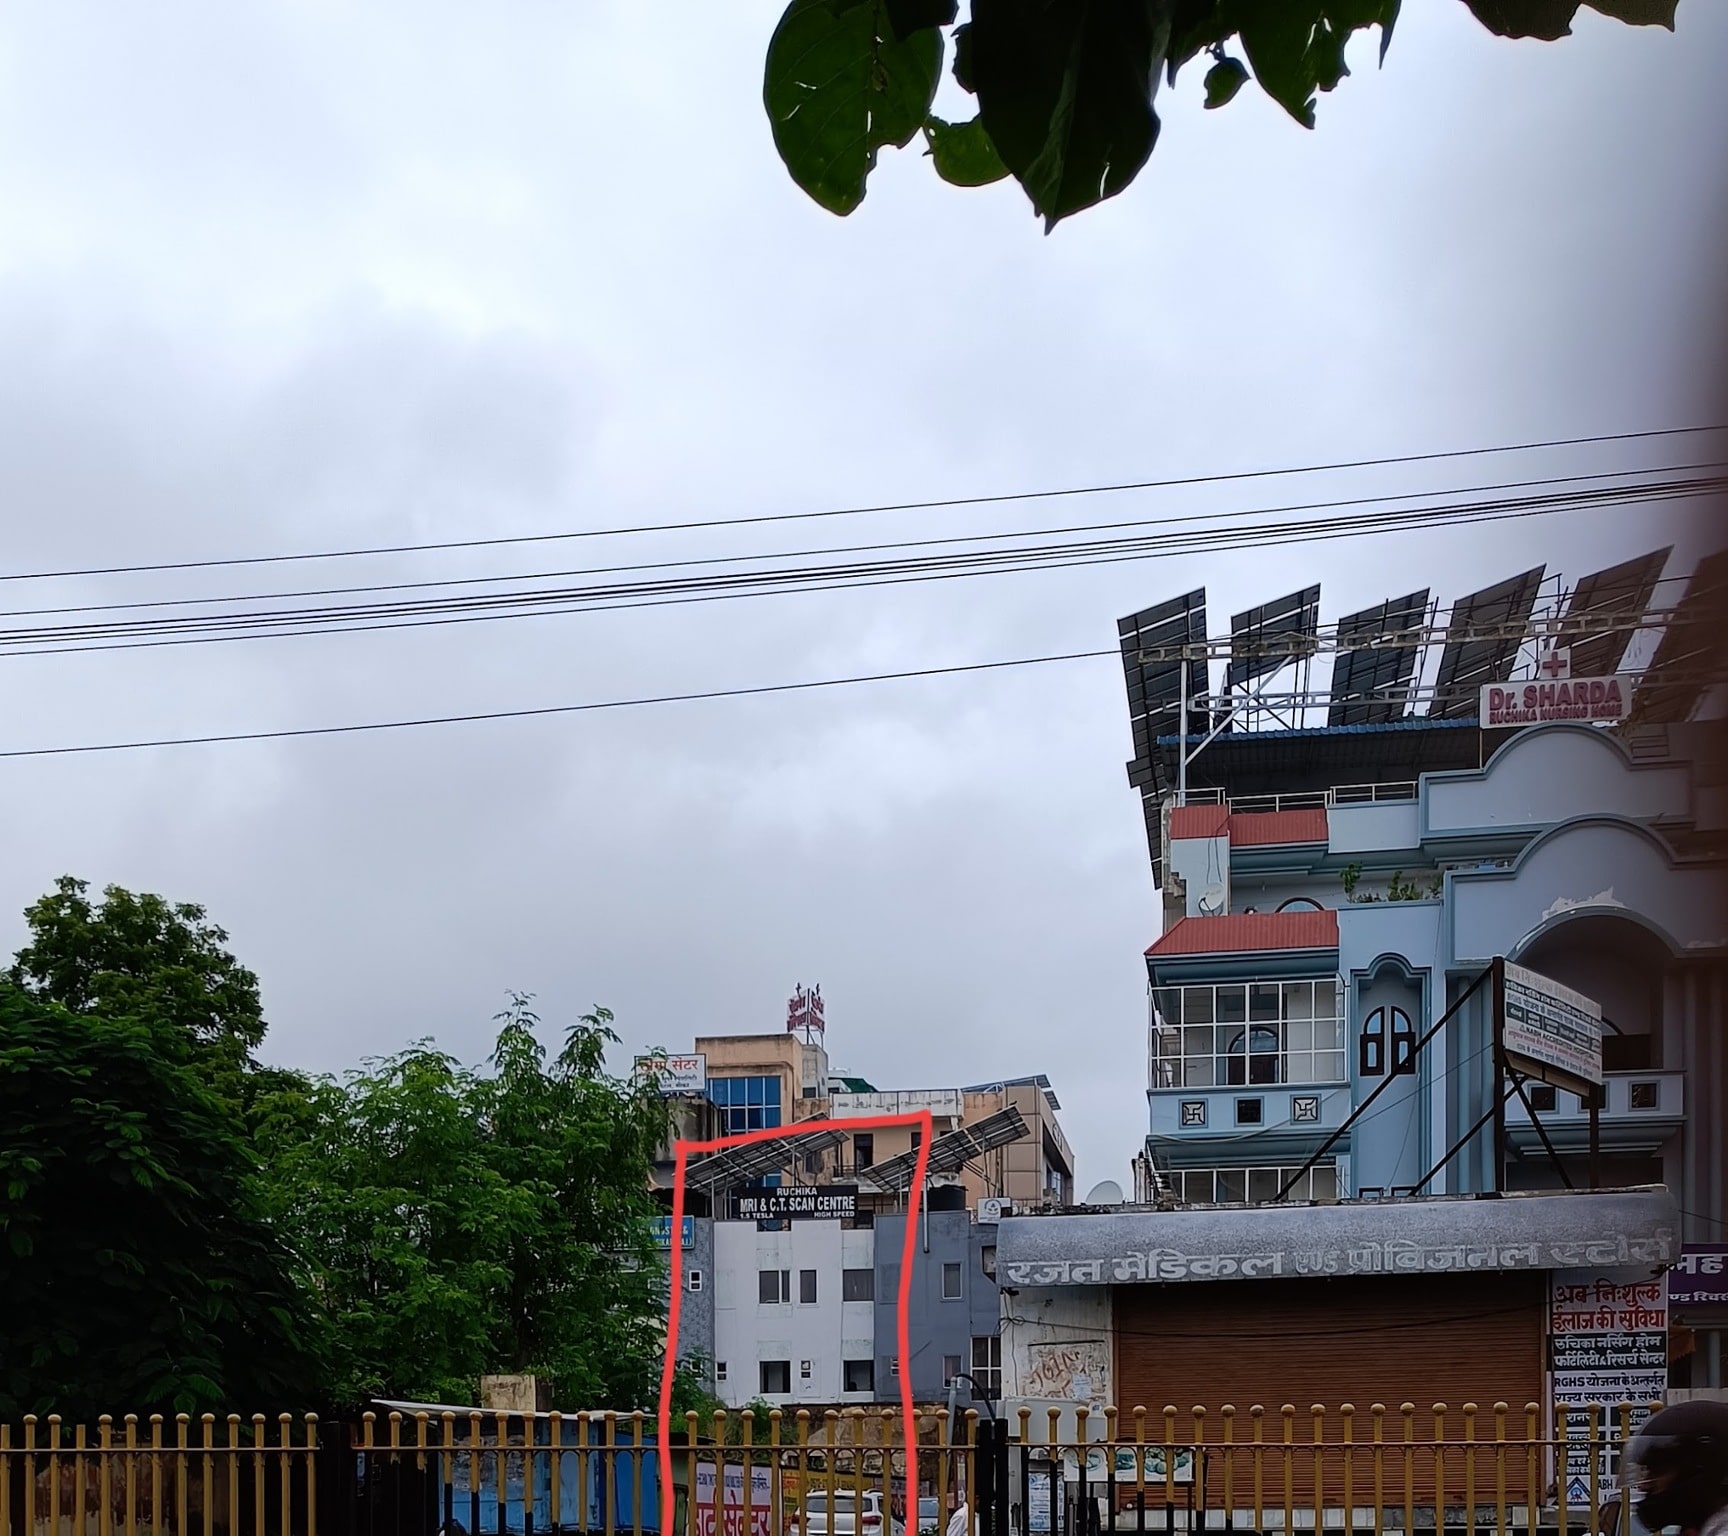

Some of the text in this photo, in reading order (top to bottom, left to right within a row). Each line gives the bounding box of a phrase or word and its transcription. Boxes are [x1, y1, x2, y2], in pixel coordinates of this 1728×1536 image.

[1489, 680, 1622, 711] Dr. SHARDA
[1489, 703, 1622, 724] RUCHIKA NURSING HOME
[776, 1187, 817, 1196] RUCHIKA
[740, 1196, 855, 1212] MRI & C.T. SCAN CENTRE
[1007, 1259, 1104, 1284] रजत
[1113, 1248, 1285, 1280] मेडिकल
[1555, 1284, 1589, 1303] अब
[1552, 1305, 1665, 1331] ईलाज की सुविधा
[1635, 1333, 1661, 1348] होम
[1554, 1377, 1585, 1387] RGHS
[1586, 1373, 1621, 1386] योजना
[1584, 1391, 1624, 1402] सरकार
[1626, 1387, 1635, 1401] के
